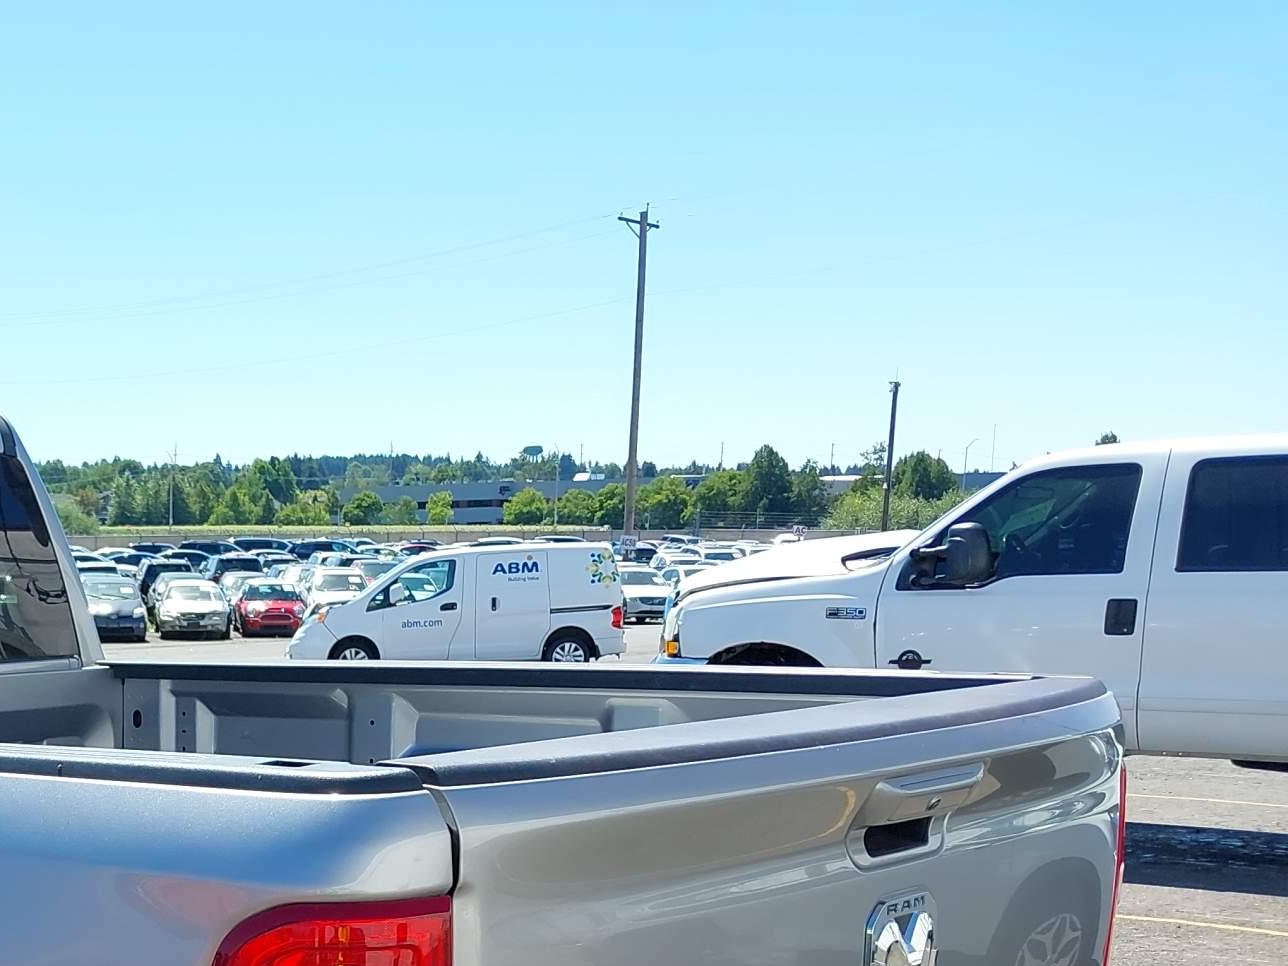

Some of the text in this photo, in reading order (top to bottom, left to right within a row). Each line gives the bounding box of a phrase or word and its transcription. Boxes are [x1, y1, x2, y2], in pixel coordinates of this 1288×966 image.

[492, 561, 539, 575] ABM
[401, 618, 443, 629] abm.com
[886, 896, 926, 916] RAM
